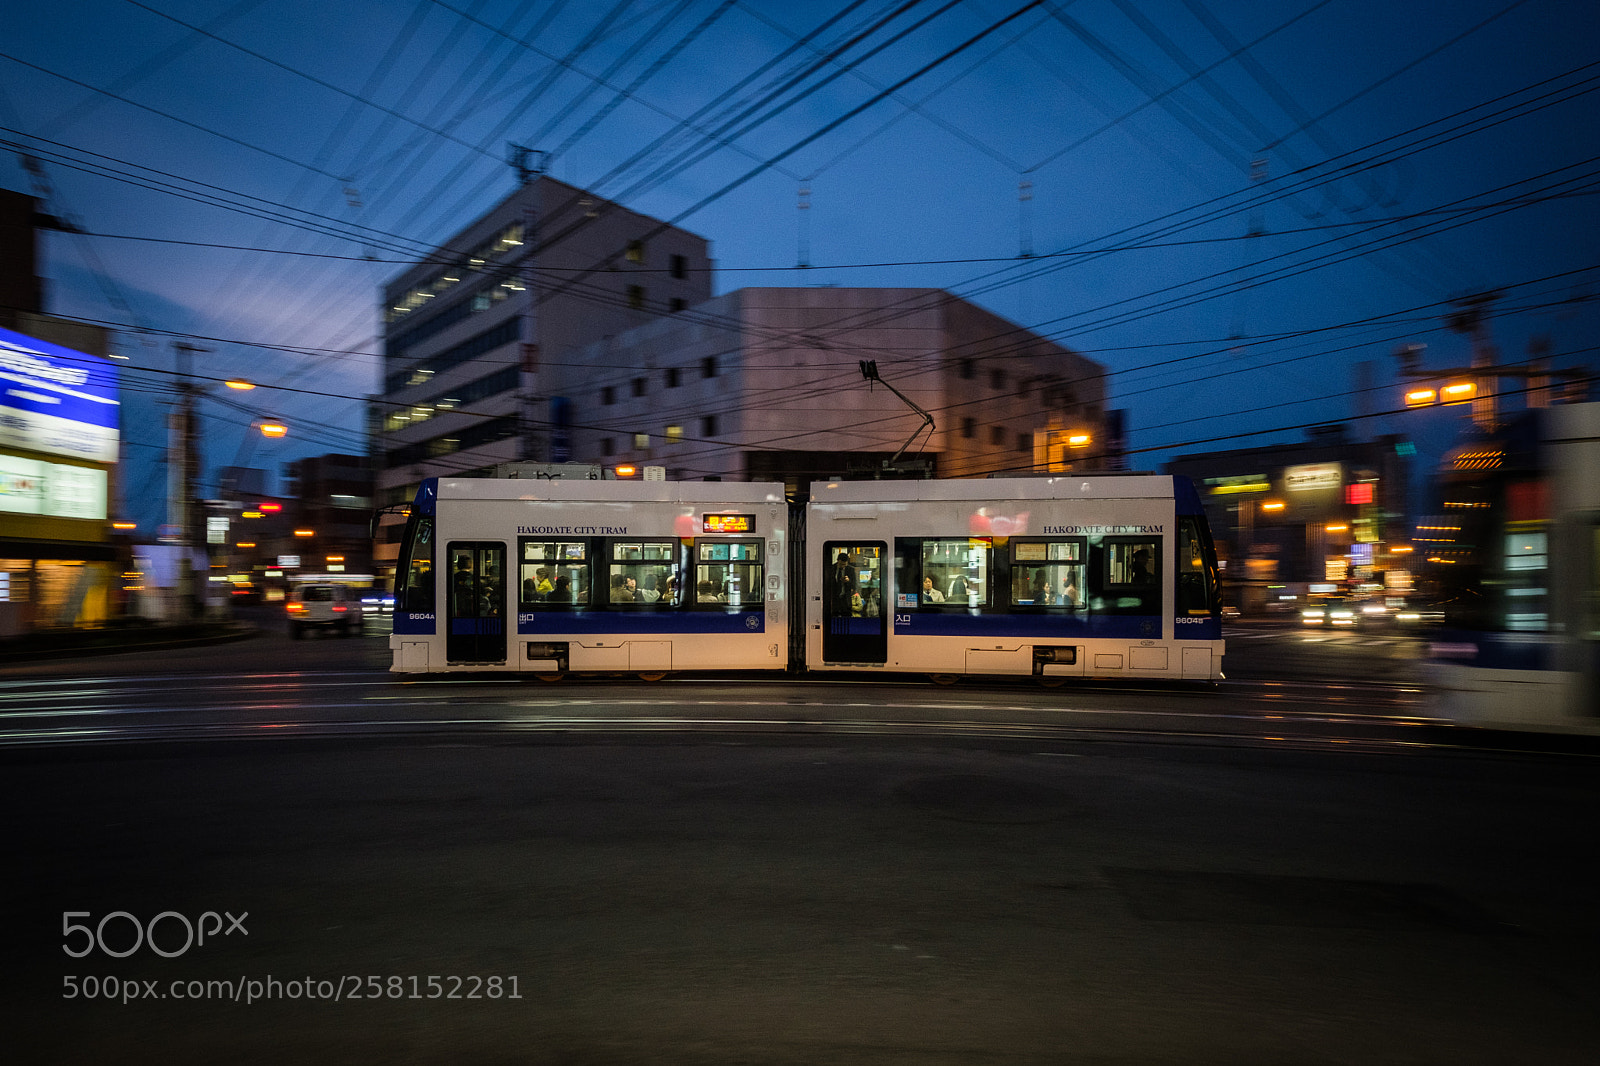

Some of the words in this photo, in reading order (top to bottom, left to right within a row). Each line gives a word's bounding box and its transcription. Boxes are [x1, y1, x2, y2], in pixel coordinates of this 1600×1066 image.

[517, 526, 572, 534] HAKODATE
[574, 526, 597, 534] CITY
[599, 526, 627, 534] TRAM
[1043, 525, 1102, 534] HAKODATE
[1104, 525, 1130, 533] CITY
[1132, 525, 1164, 533] TRAM
[519, 613, 534, 621] 出口
[895, 614, 911, 622] 入口
